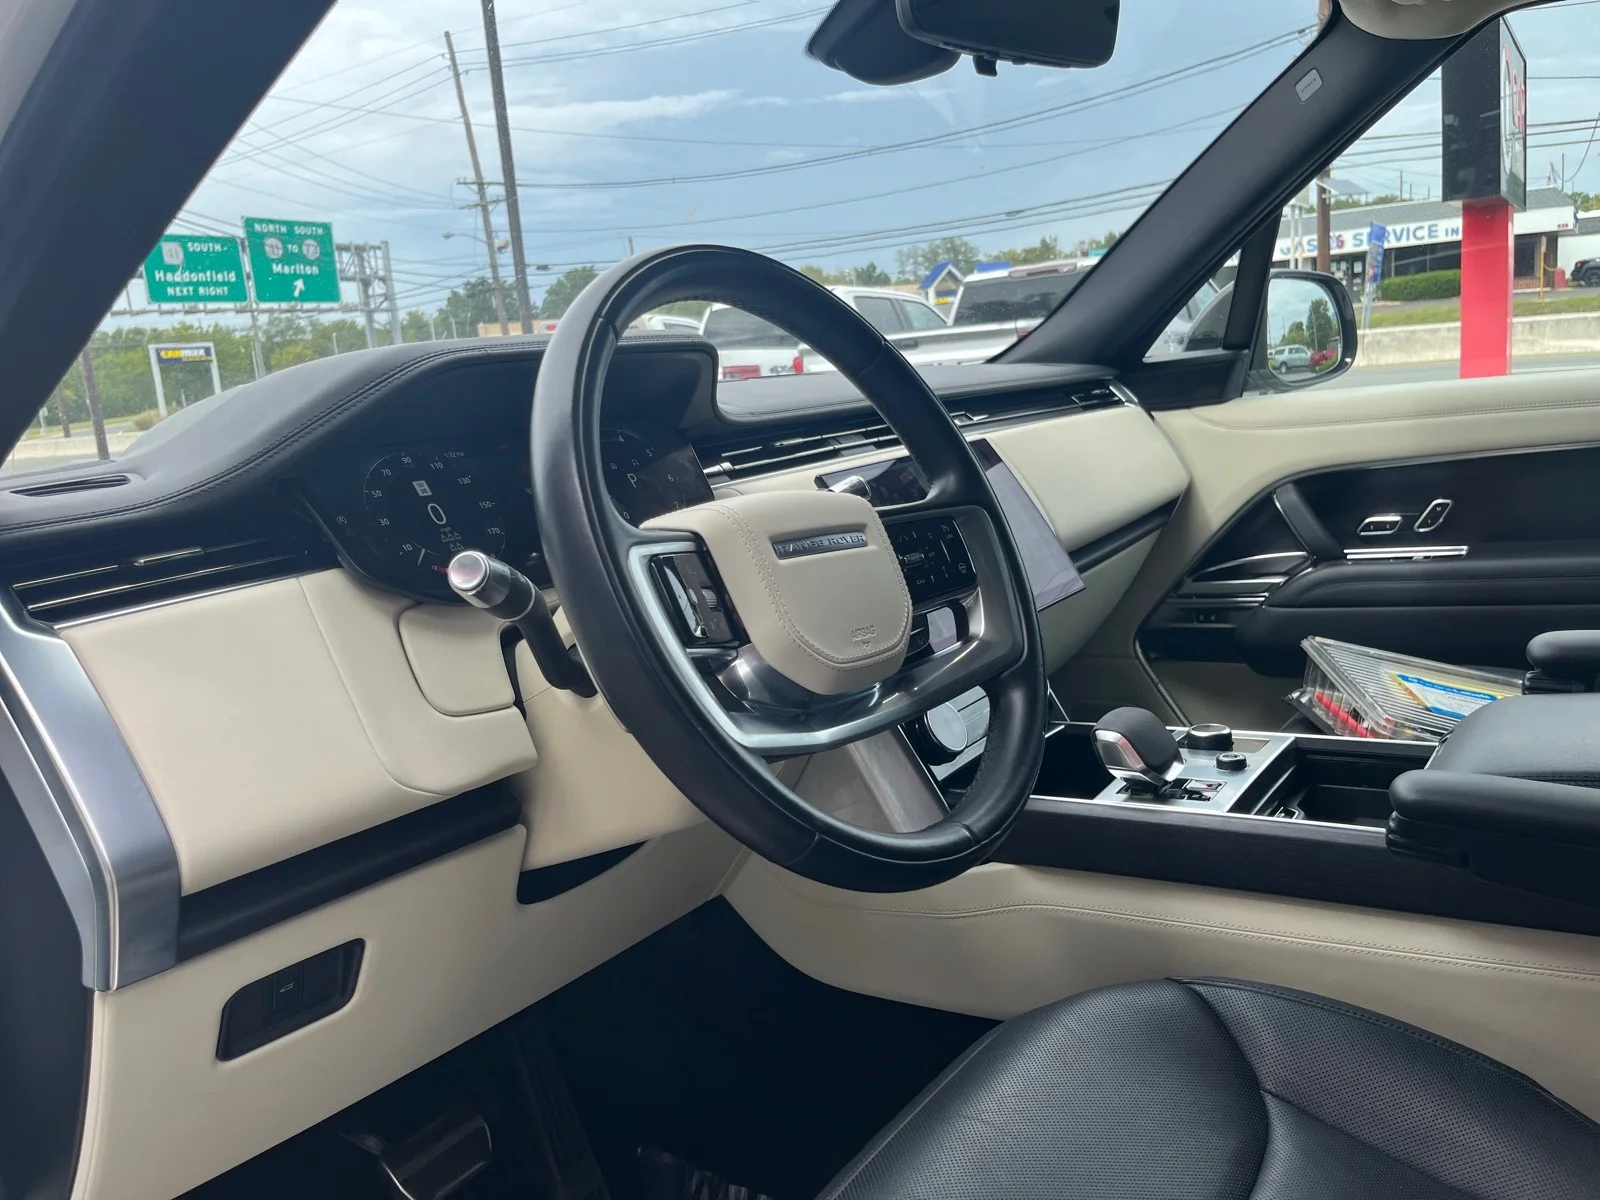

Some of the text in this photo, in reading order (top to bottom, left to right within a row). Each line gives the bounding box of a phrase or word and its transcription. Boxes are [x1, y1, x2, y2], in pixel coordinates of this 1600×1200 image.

[254, 222, 324, 236] NORTH SOUTH
[1352, 223, 1439, 247] SRVICE
[187, 241, 222, 253] SOUTH
[287, 243, 299, 253] TO
[272, 262, 320, 276] Marlton
[154, 269, 237, 283] Haddonfield
[166, 285, 229, 297] NEXT RIGHT
[401, 456, 412, 464] 90
[429, 462, 444, 471] 110
[380, 468, 392, 477] 70
[457, 476, 471, 485] 130
[626, 473, 637, 488] P
[667, 474, 675, 482] 6
[371, 489, 383, 498] 50
[479, 500, 493, 509] 150
[427, 503, 447, 525] 0
[378, 518, 390, 527] 30
[487, 527, 501, 536] 170
[402, 543, 413, 552] 10
